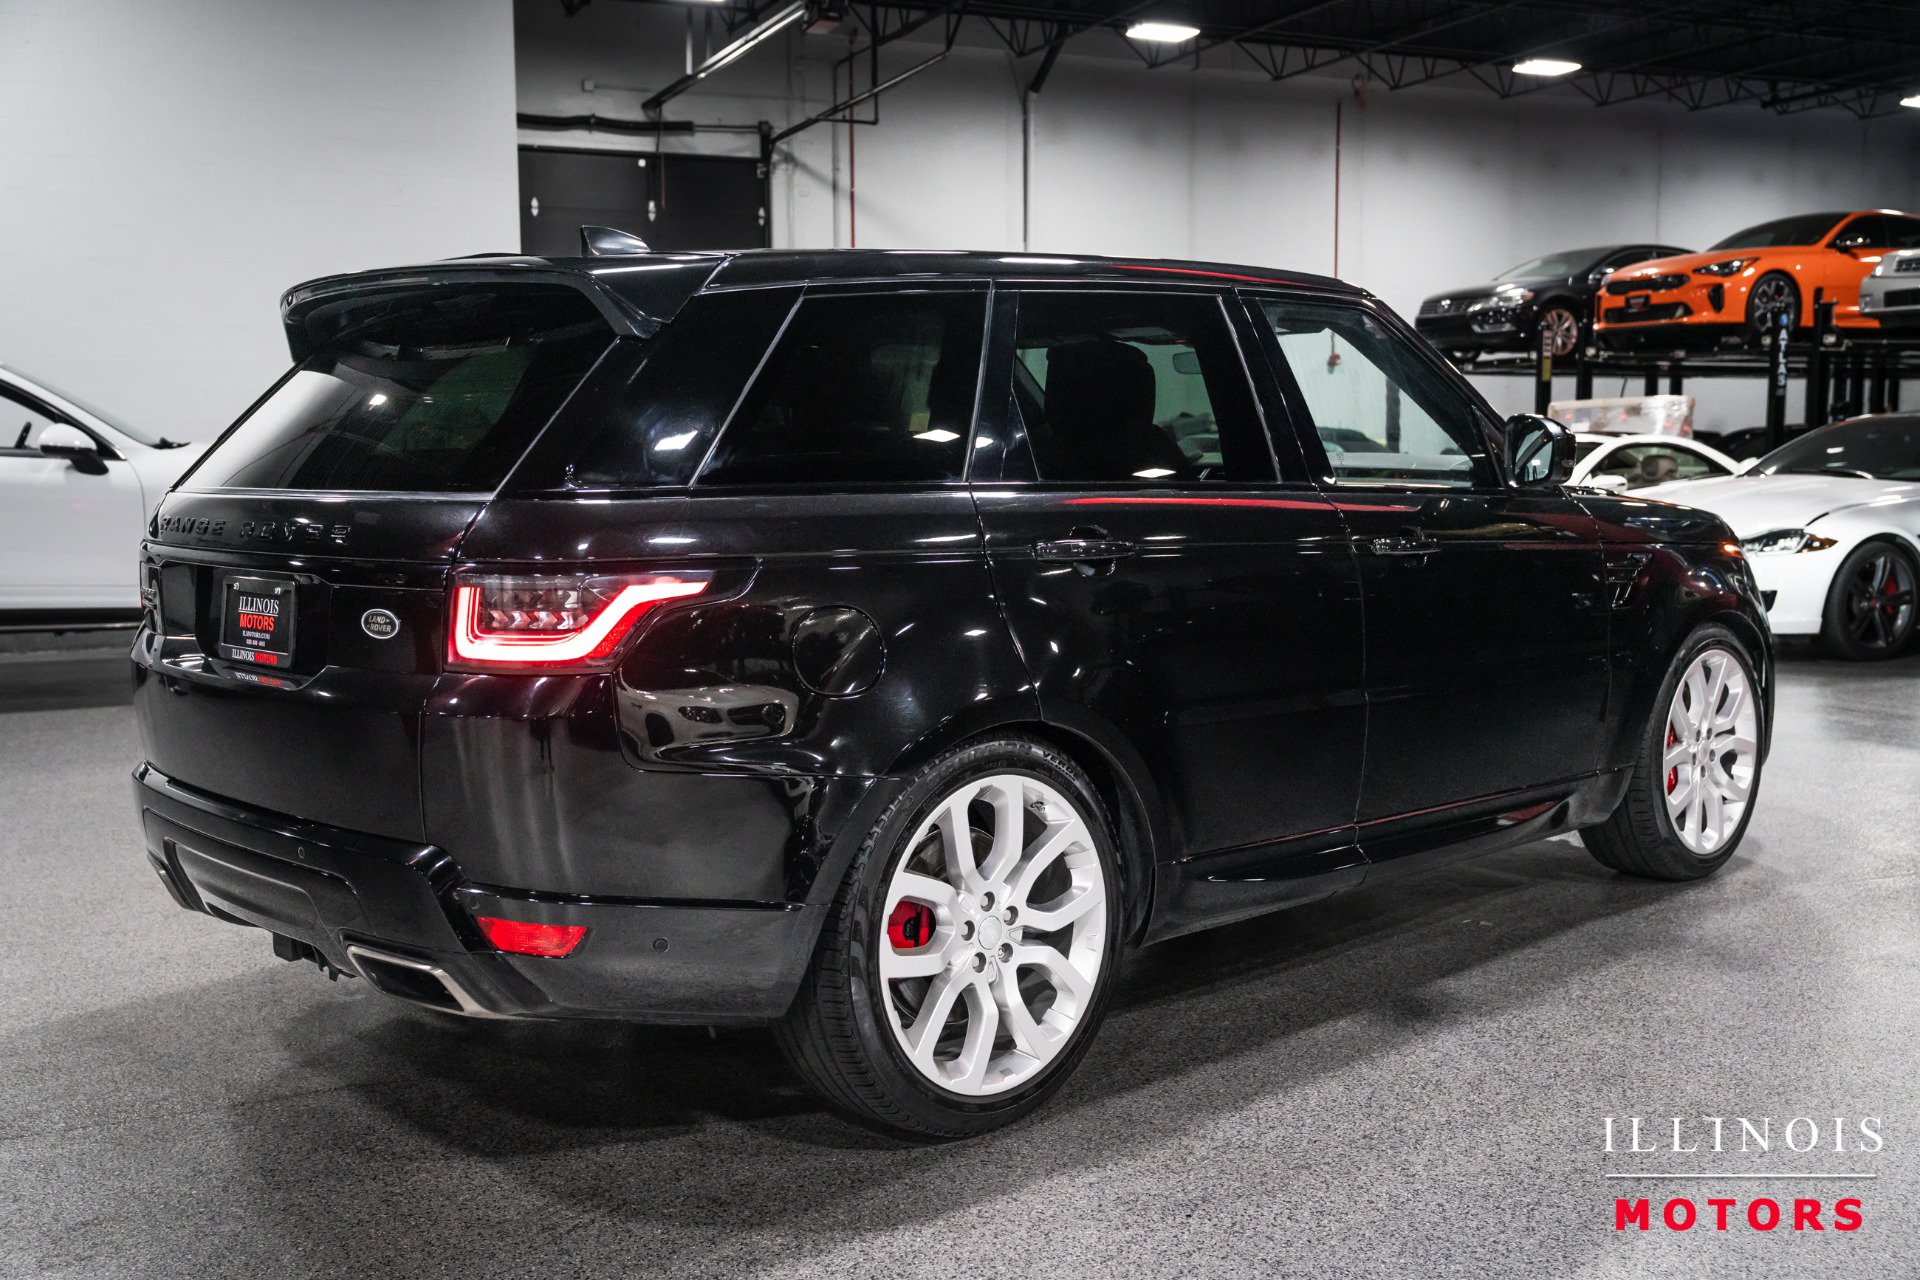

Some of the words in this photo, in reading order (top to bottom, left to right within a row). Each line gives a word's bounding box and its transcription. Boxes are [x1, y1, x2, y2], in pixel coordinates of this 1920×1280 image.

[161, 516, 226, 536] RANGE
[240, 521, 351, 545] ROVER
[239, 596, 280, 615] ILLINOIS
[240, 613, 275, 631] MOTORS
[370, 623, 392, 633] ROVER
[232, 648, 255, 662] ILLINOIS
[254, 650, 278, 665] MOTORS
